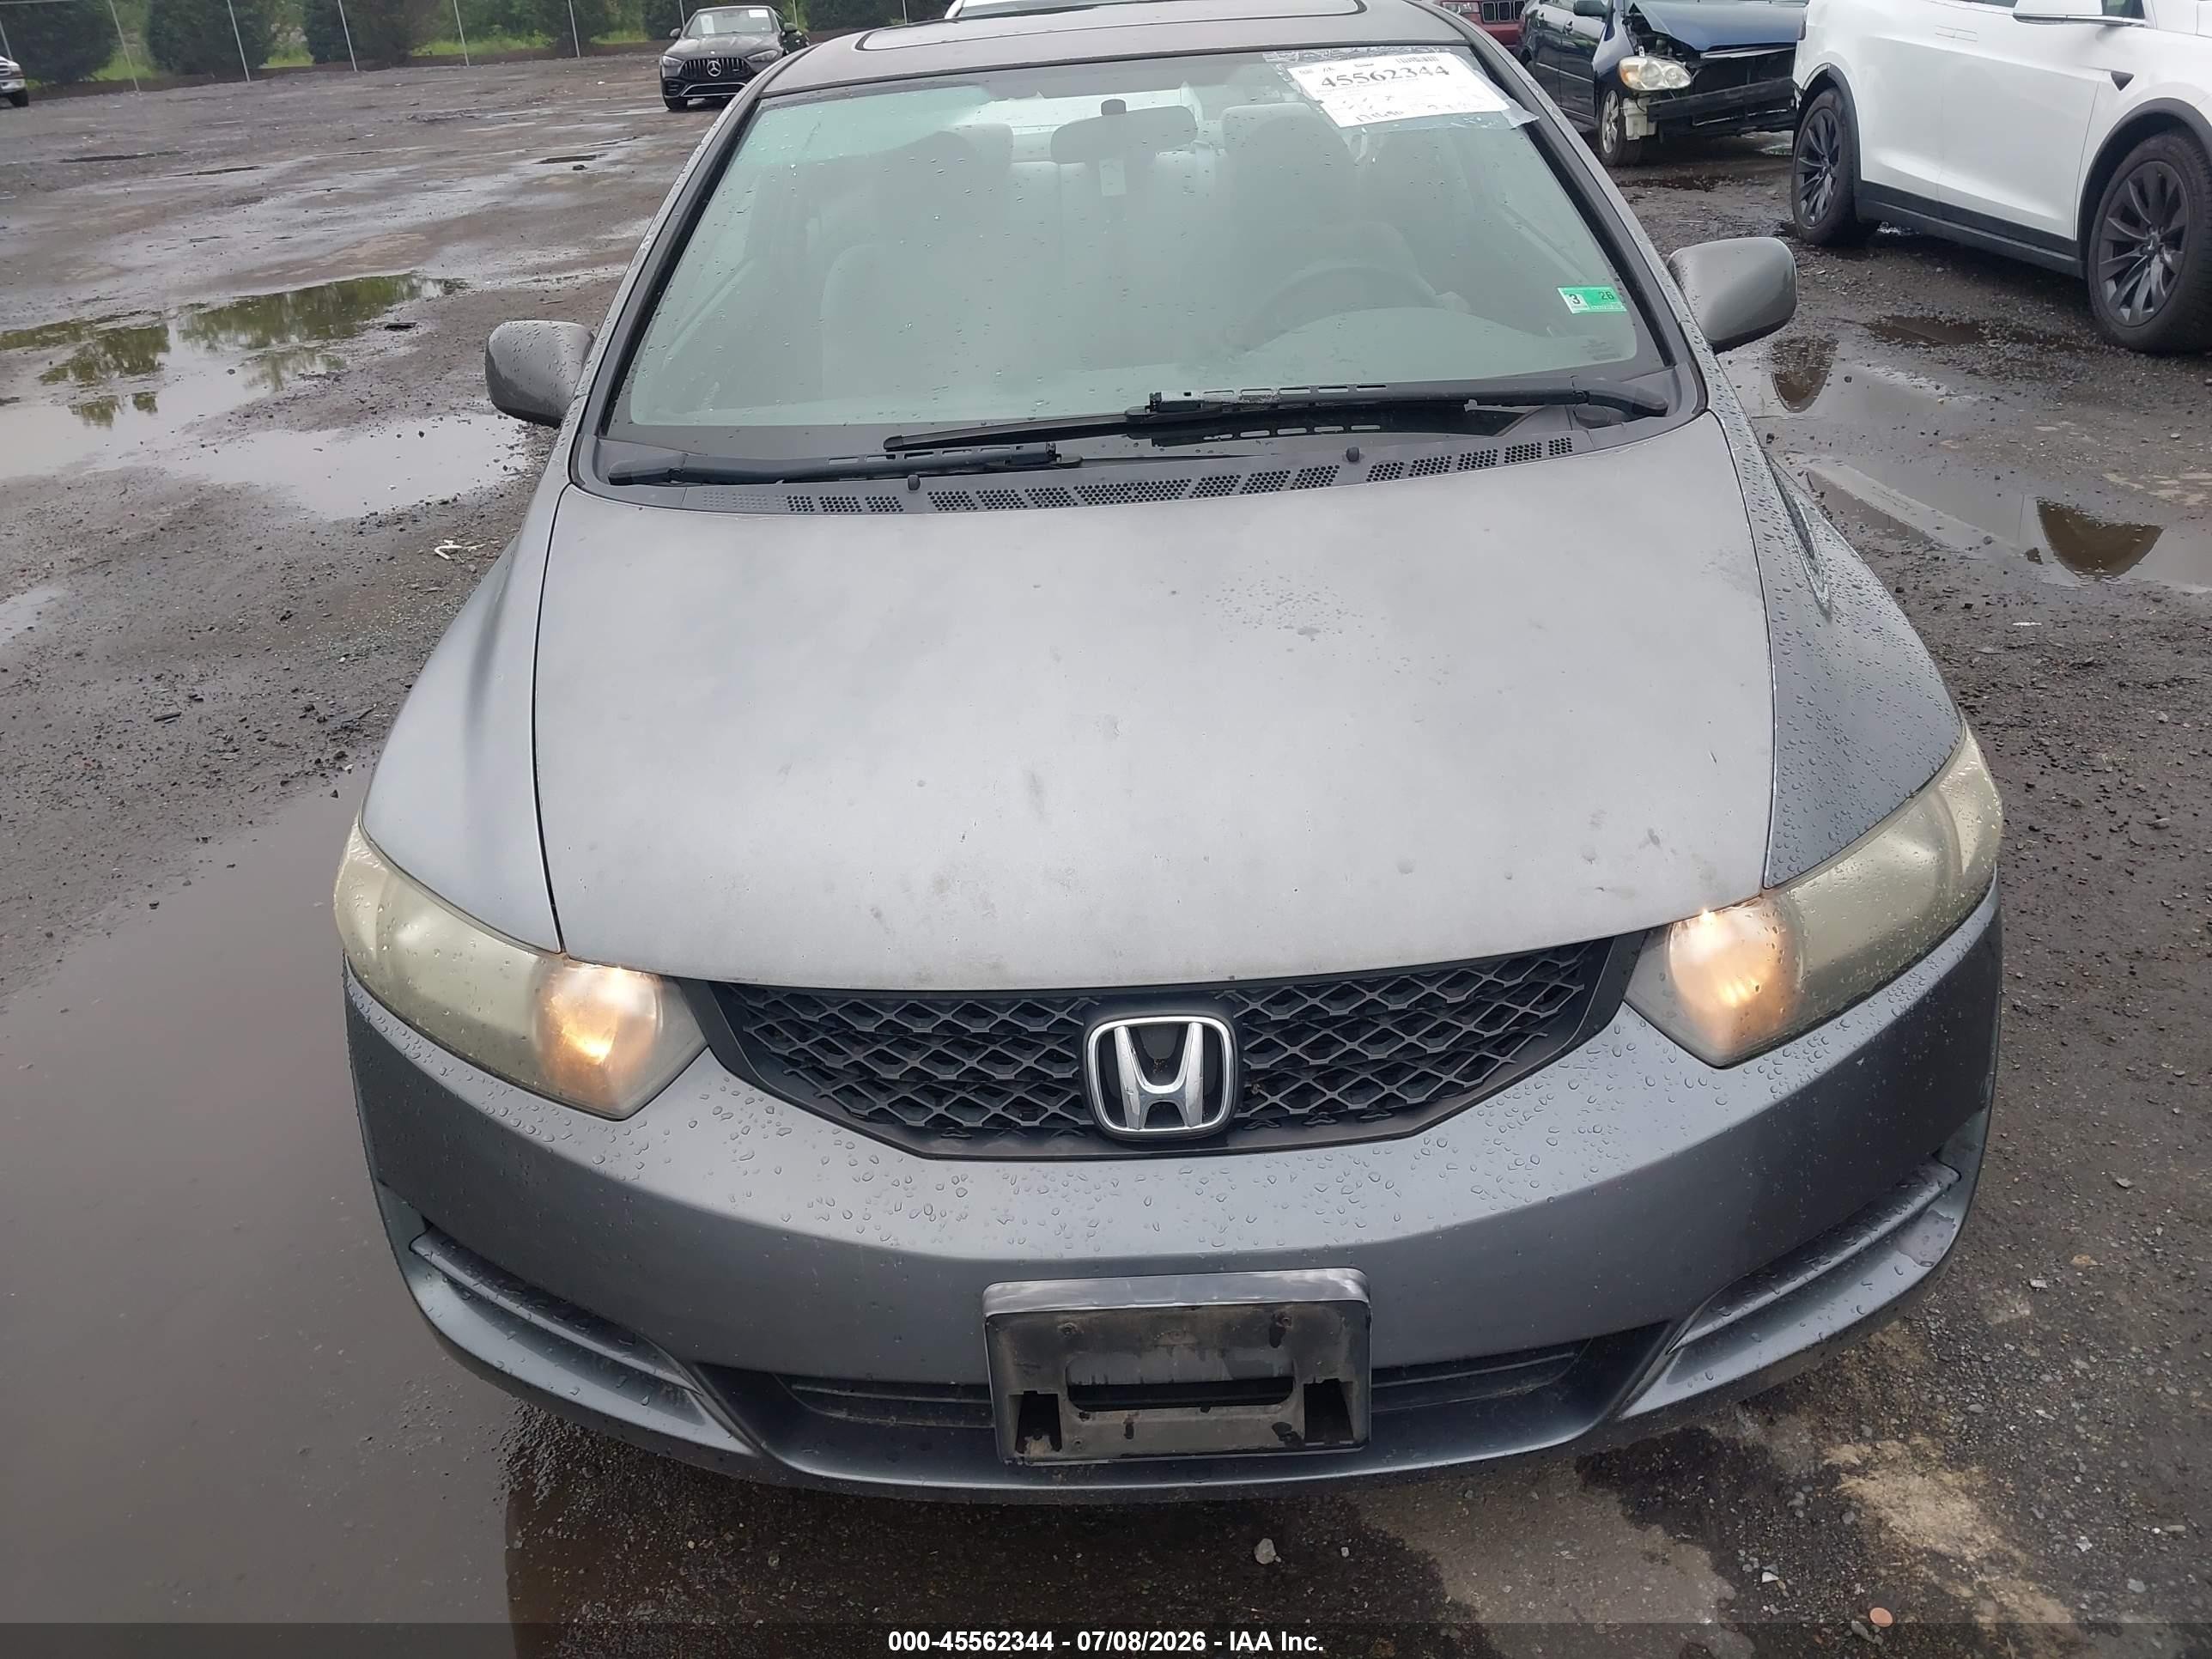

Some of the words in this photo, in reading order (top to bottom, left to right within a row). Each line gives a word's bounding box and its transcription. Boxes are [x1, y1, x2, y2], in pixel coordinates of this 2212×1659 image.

[1321, 65, 1450, 88] 45562344
[1569, 294, 1581, 304] 3
[1599, 291, 1614, 300] 26
